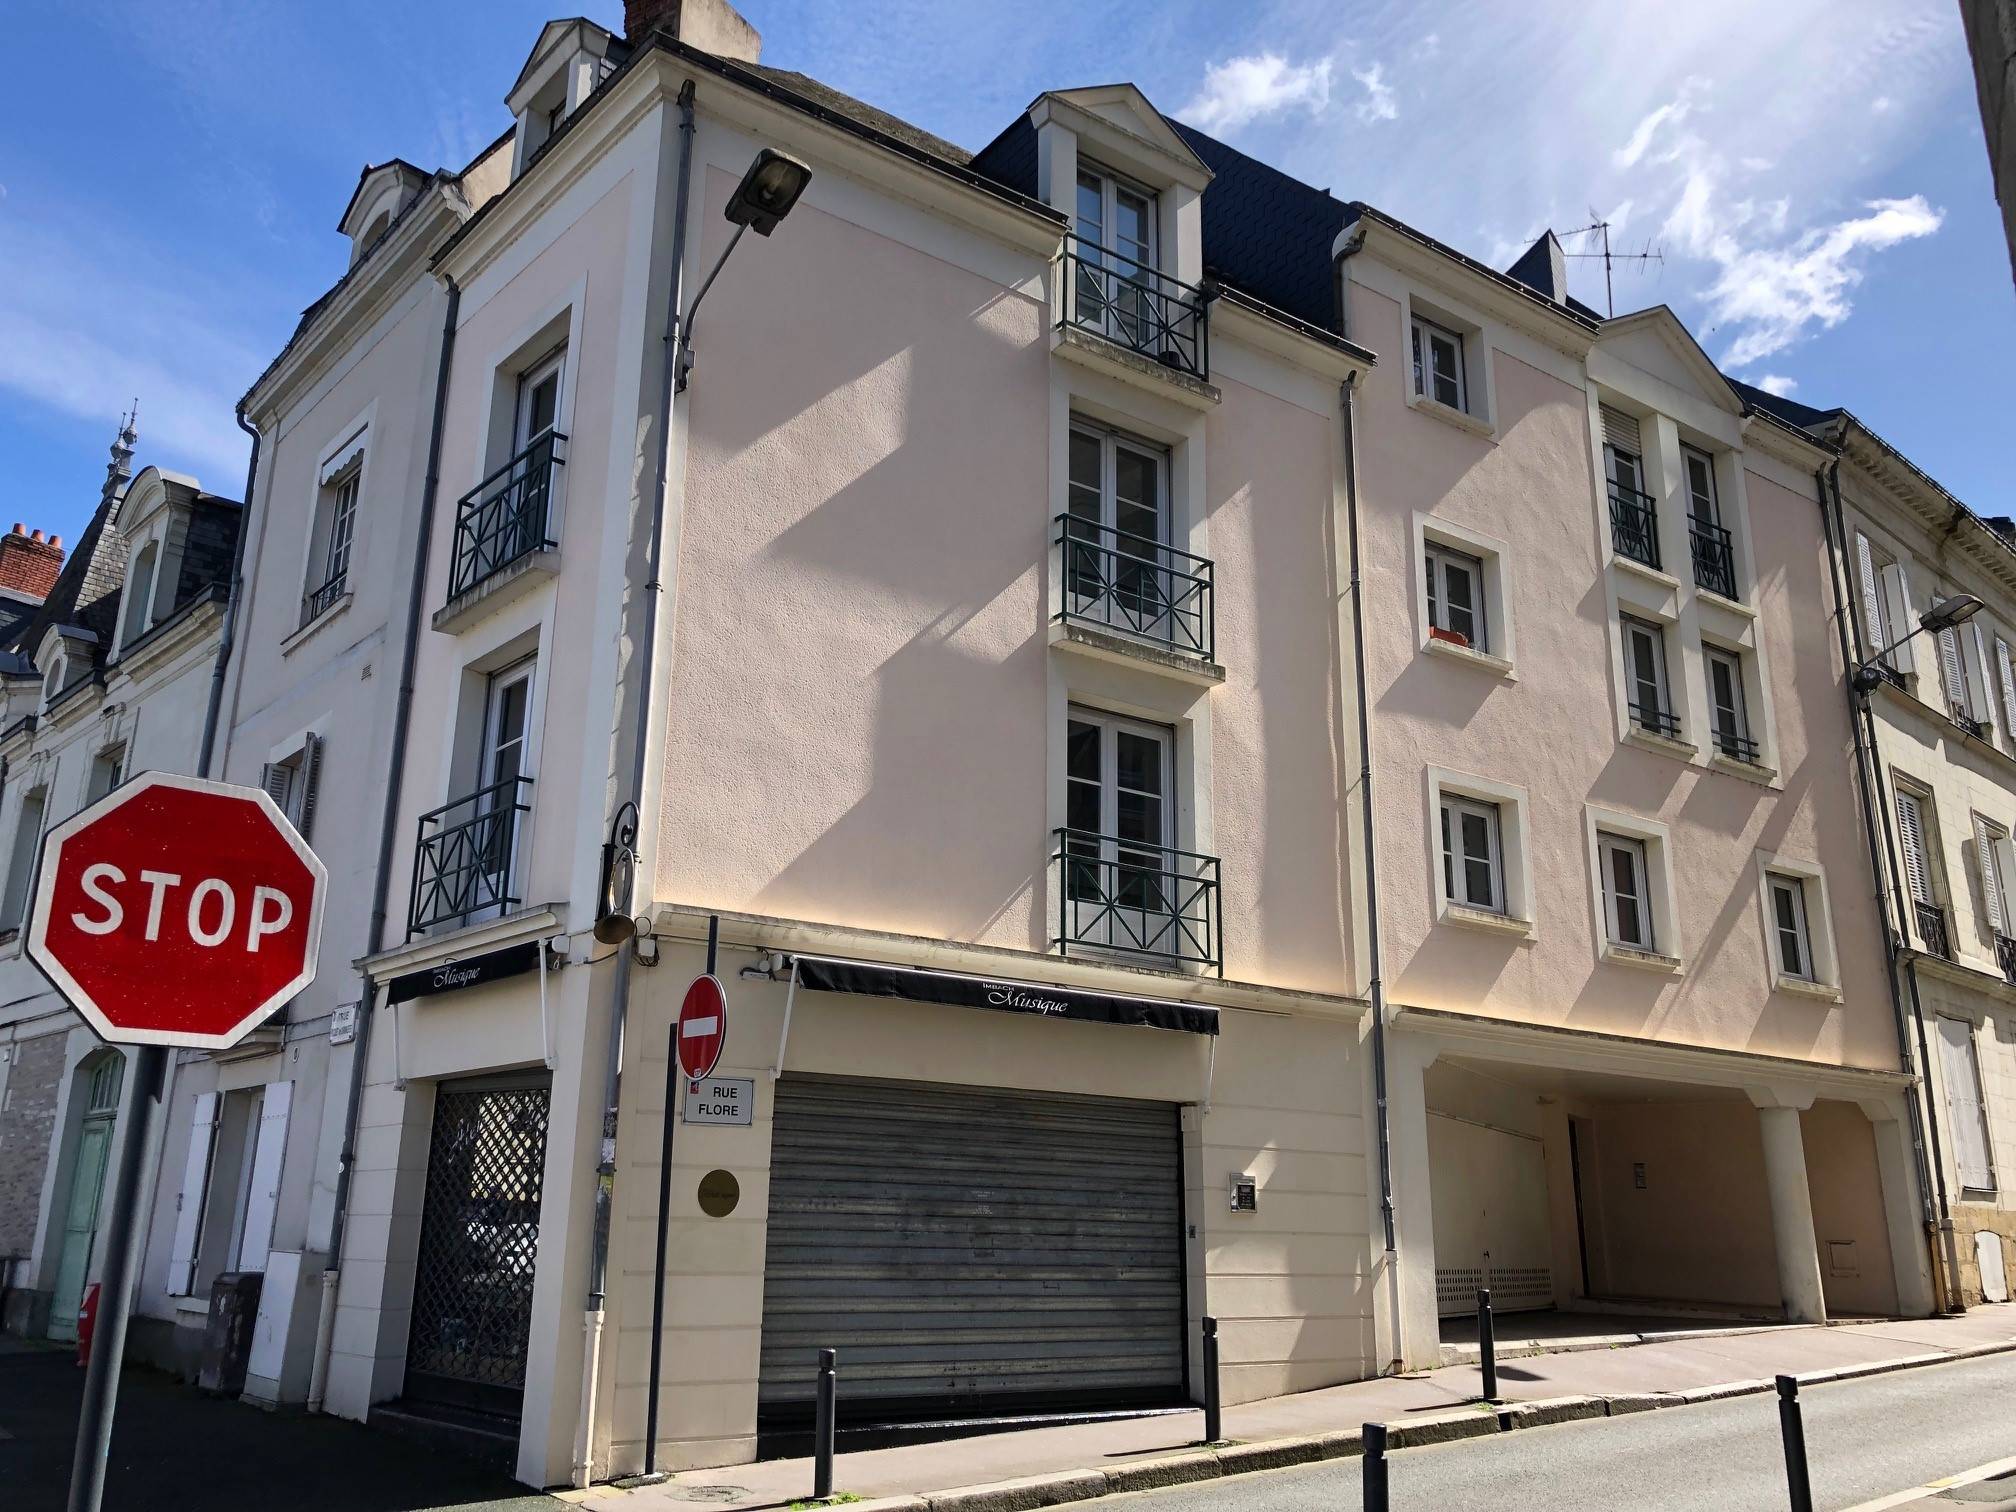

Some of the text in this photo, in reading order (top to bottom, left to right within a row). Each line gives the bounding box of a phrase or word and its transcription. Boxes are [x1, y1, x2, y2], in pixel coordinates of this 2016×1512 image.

[71, 863, 293, 953] STOP
[987, 991, 1069, 1015] Musique
[713, 1086, 738, 1099] RUE
[698, 1103, 739, 1116] FLORE
